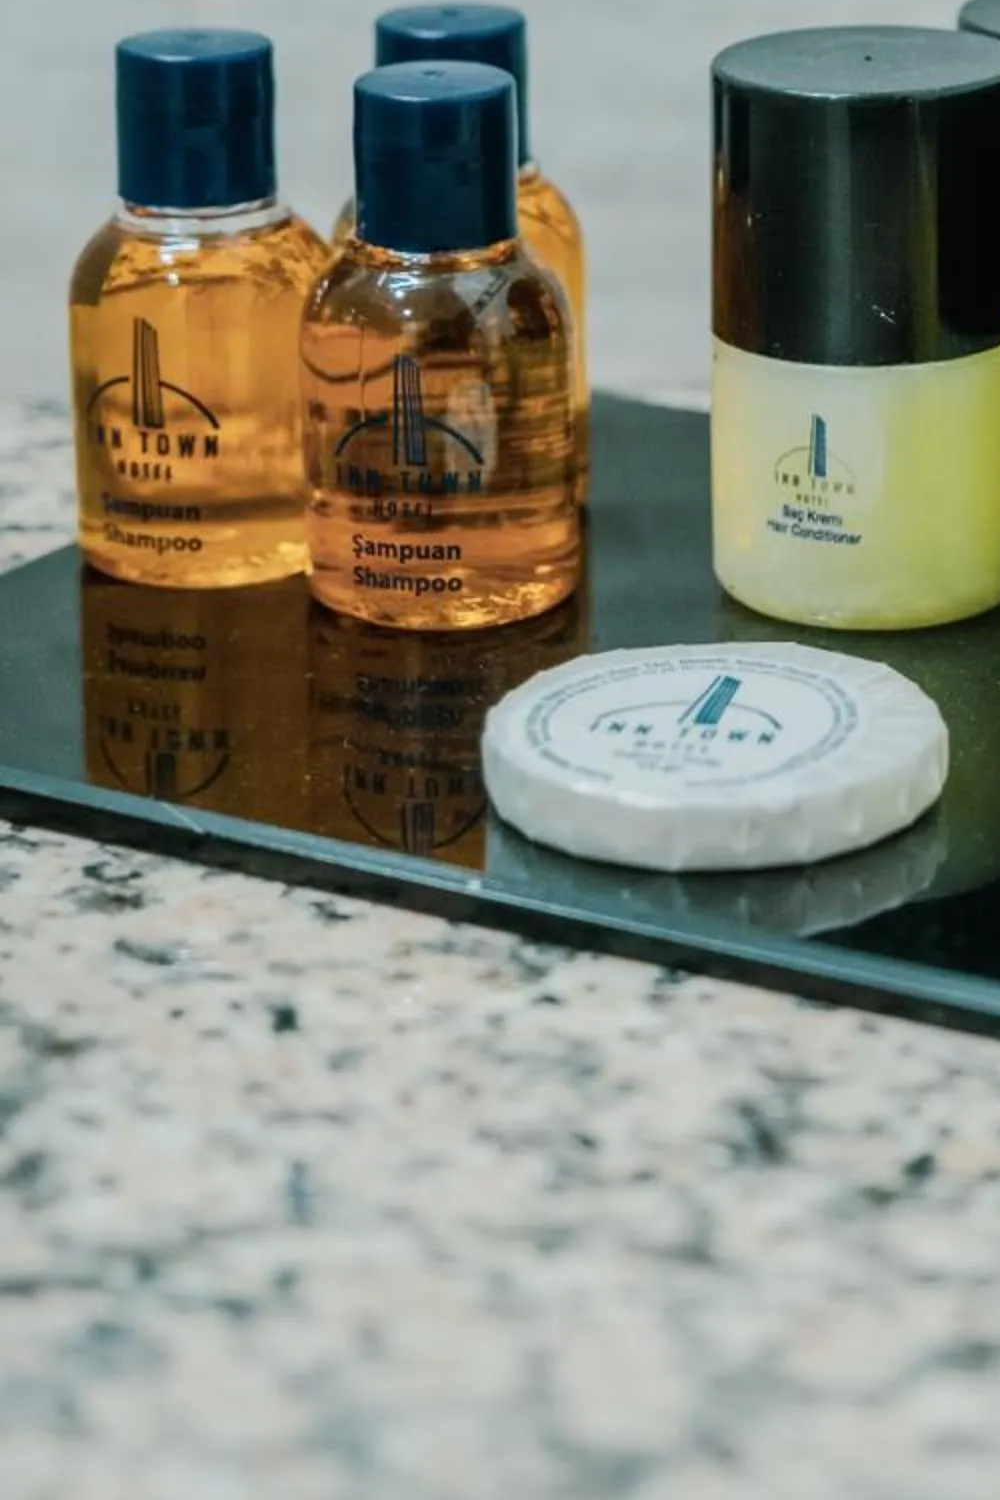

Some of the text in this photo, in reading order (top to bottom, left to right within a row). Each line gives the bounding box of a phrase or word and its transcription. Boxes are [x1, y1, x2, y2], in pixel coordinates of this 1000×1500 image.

[139, 429, 219, 459] TOWN
[352, 534, 462, 565] Şampuan
[790, 523, 863, 546] Conditioner
[353, 565, 463, 597] Shampoo
[679, 726, 777, 745] TOWN
